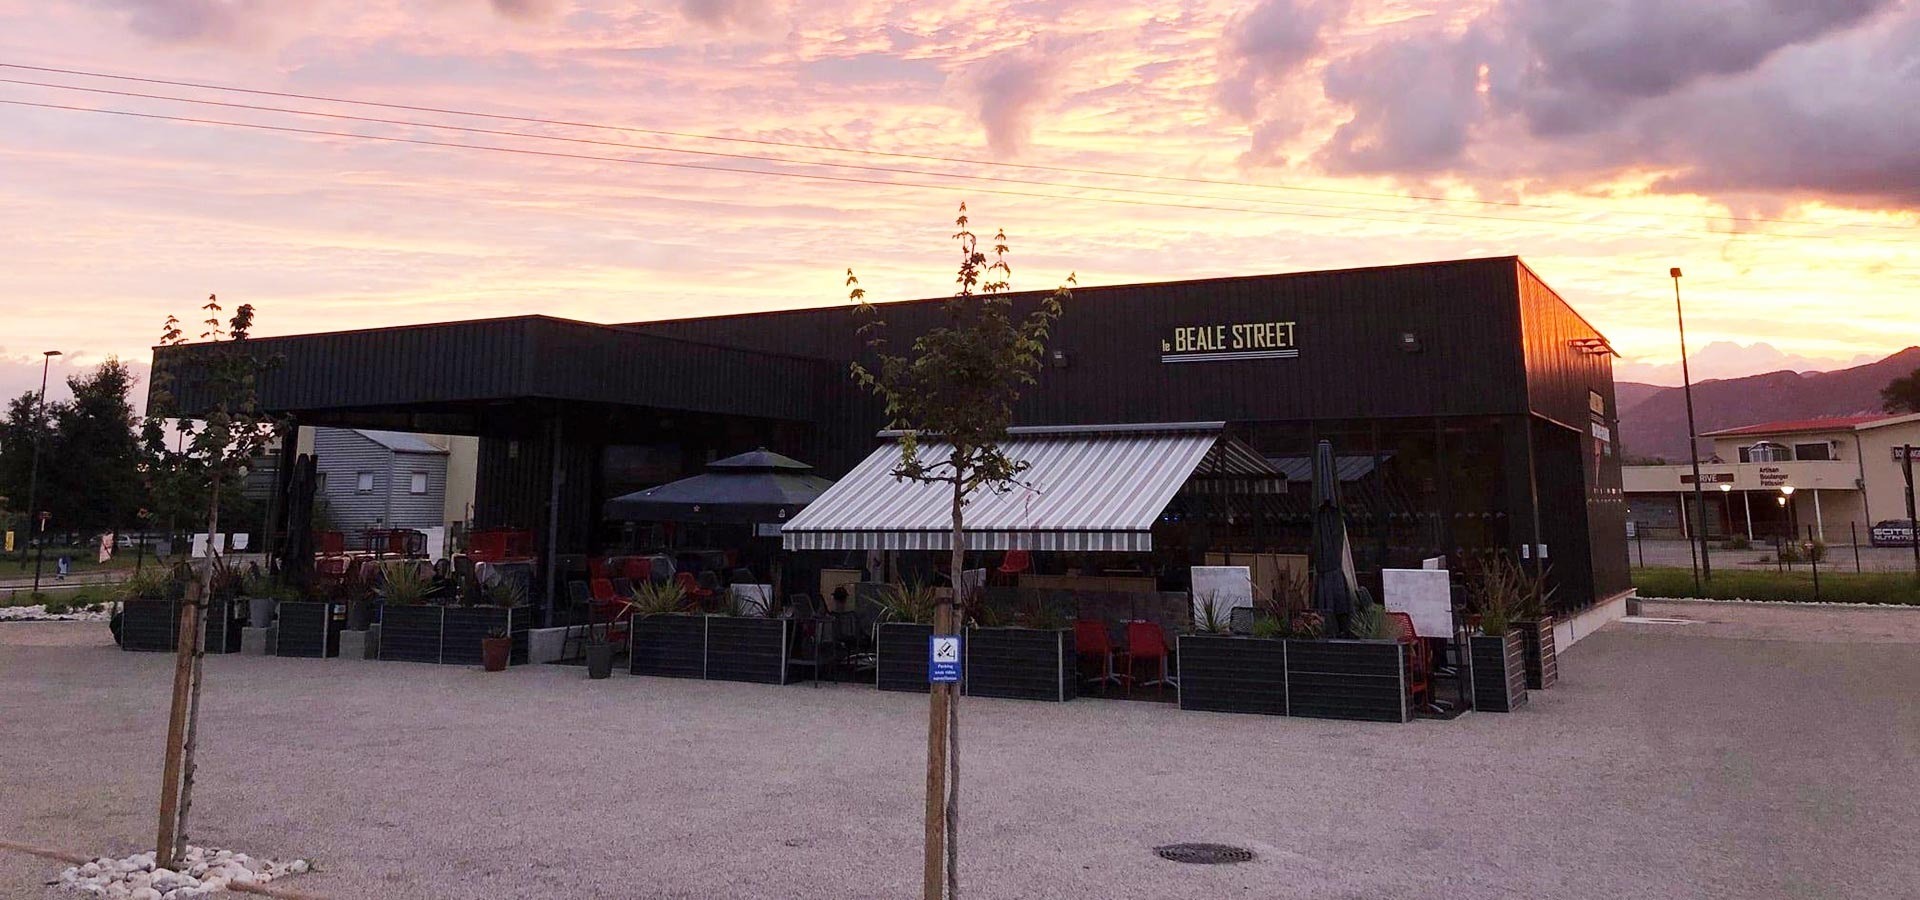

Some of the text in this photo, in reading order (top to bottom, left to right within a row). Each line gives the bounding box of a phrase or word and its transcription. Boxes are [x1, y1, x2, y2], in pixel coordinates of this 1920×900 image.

[1162, 321, 1296, 352] le BEALE STREET
[1697, 474, 1718, 482] RIVE
